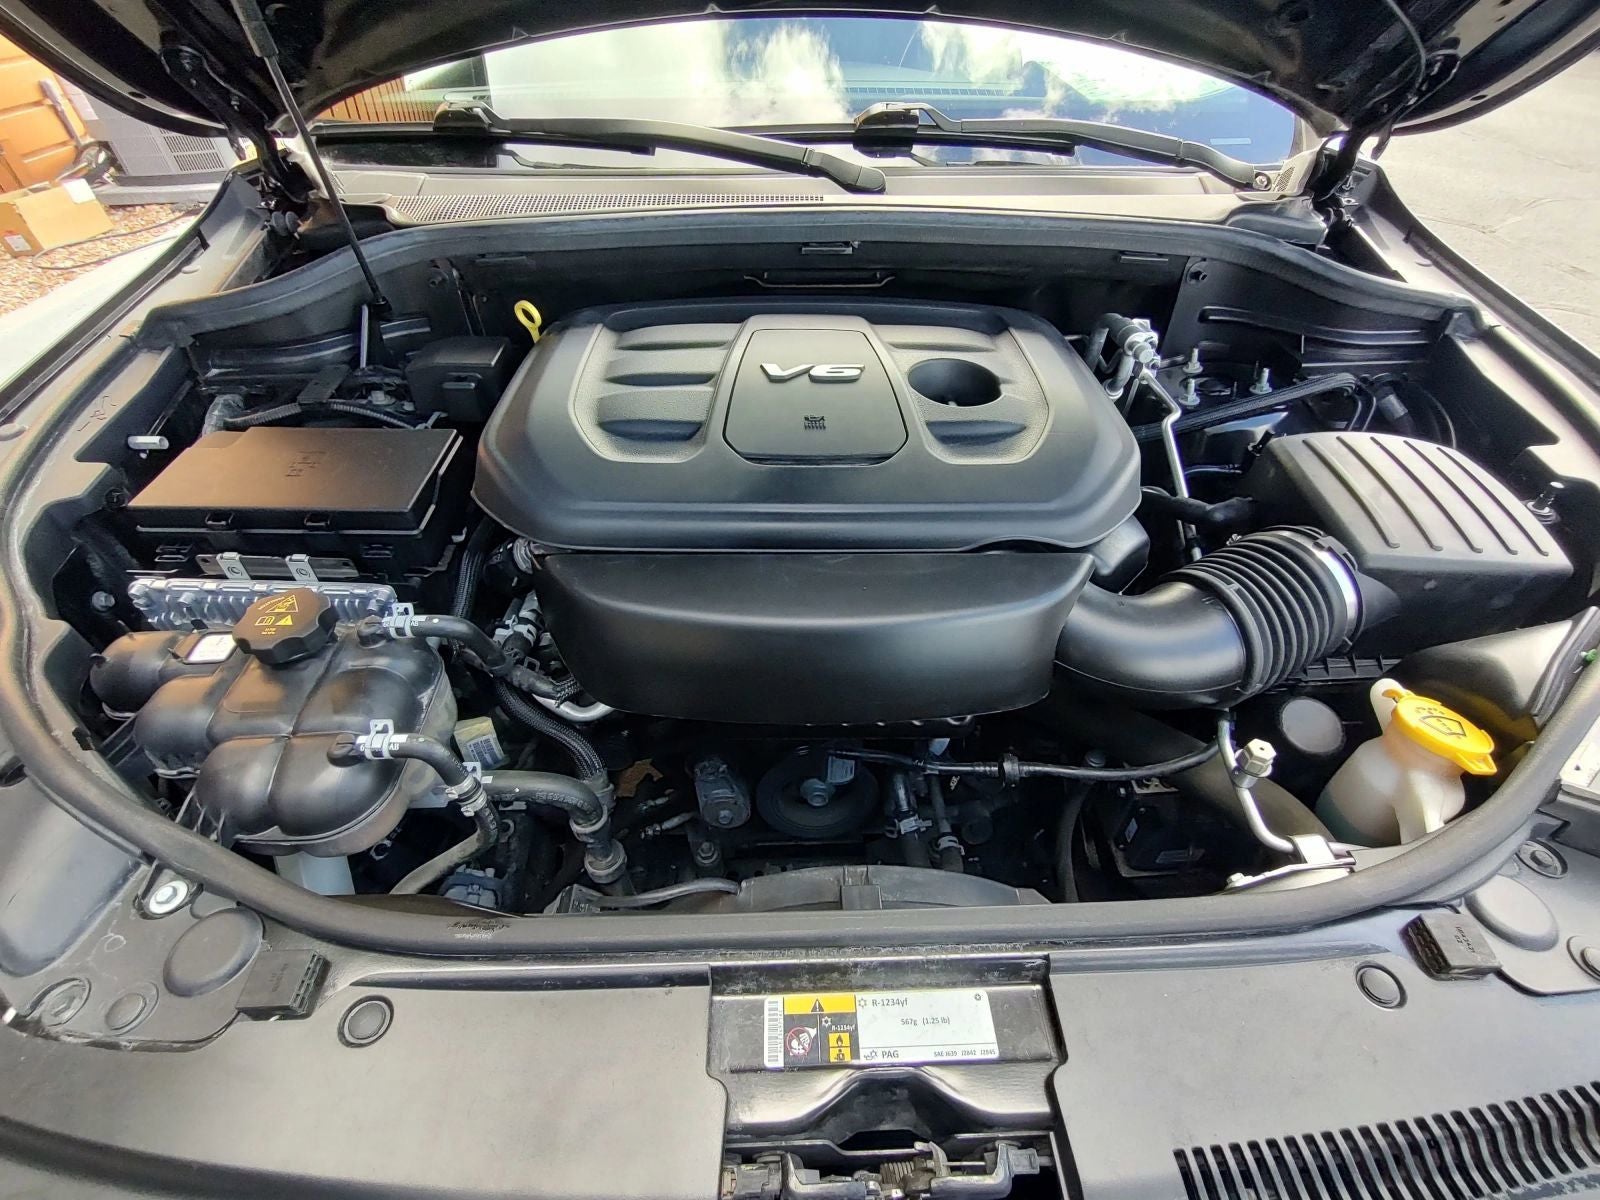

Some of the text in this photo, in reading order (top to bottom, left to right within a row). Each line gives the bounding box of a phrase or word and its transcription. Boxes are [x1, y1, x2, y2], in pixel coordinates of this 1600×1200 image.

[760, 363, 866, 384] V6
[872, 997, 908, 1008] R-1234yf
[900, 1016, 951, 1026] 567g (1.25 lb)
[881, 1050, 900, 1059] PAG
